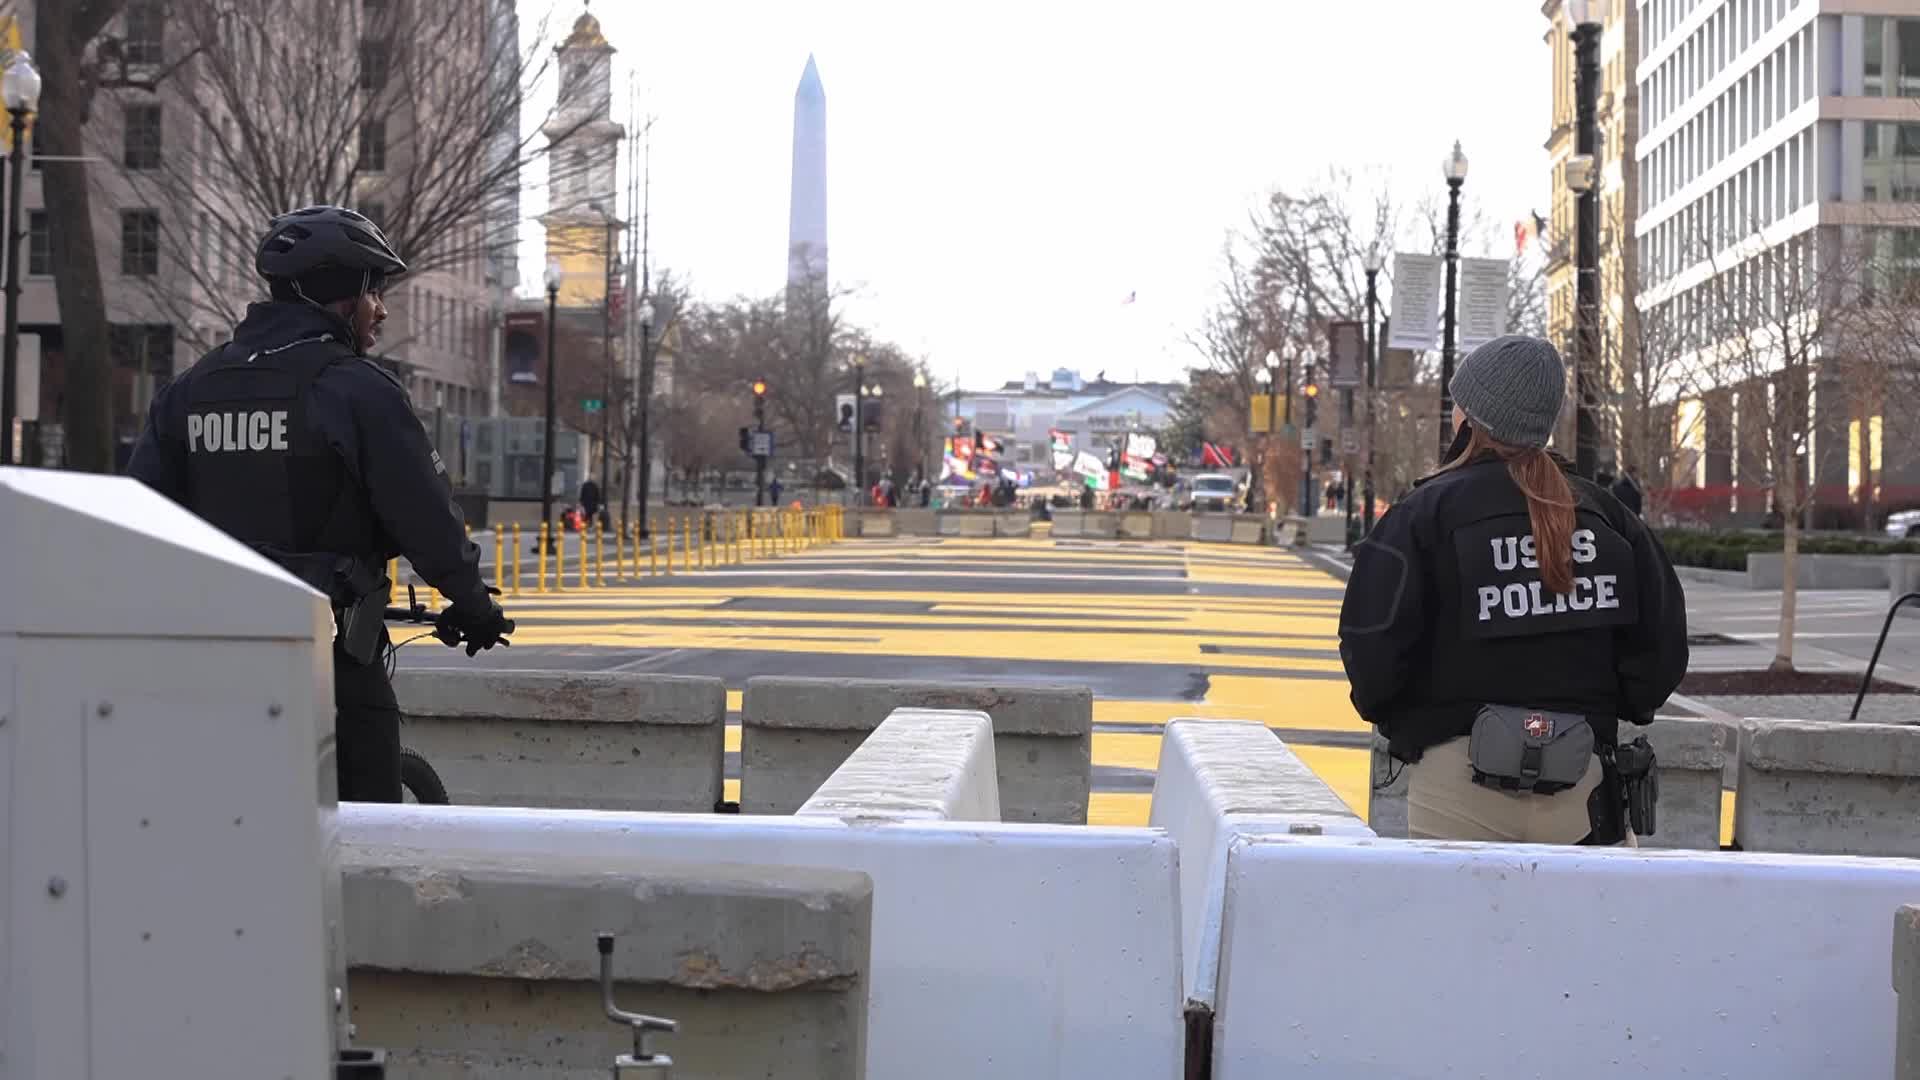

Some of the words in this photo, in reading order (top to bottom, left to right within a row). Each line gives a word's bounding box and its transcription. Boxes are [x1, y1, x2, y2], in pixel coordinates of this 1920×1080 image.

[187, 410, 289, 453] POLICE
[1491, 529, 1597, 571] USS
[1478, 575, 1619, 621] POLICE
